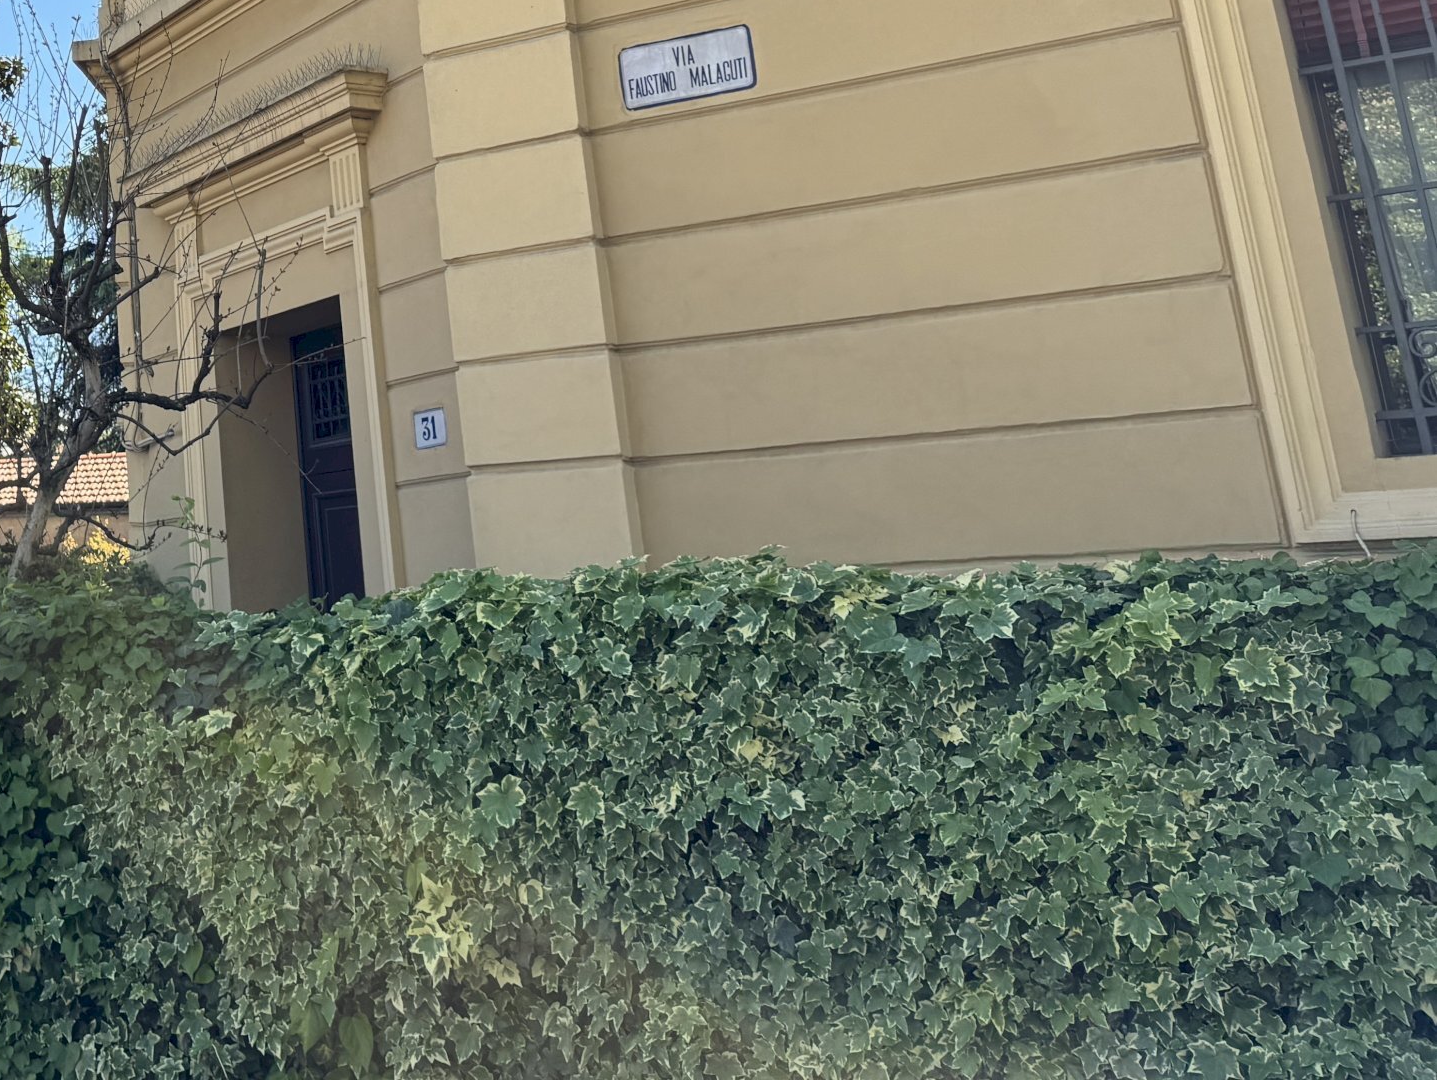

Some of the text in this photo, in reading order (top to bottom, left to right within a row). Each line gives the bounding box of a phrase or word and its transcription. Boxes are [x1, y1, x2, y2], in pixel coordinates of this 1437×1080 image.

[672, 44, 695, 67] VIA
[628, 56, 748, 100] FAUSTINO MALAGUTI
[421, 415, 438, 441] 31
